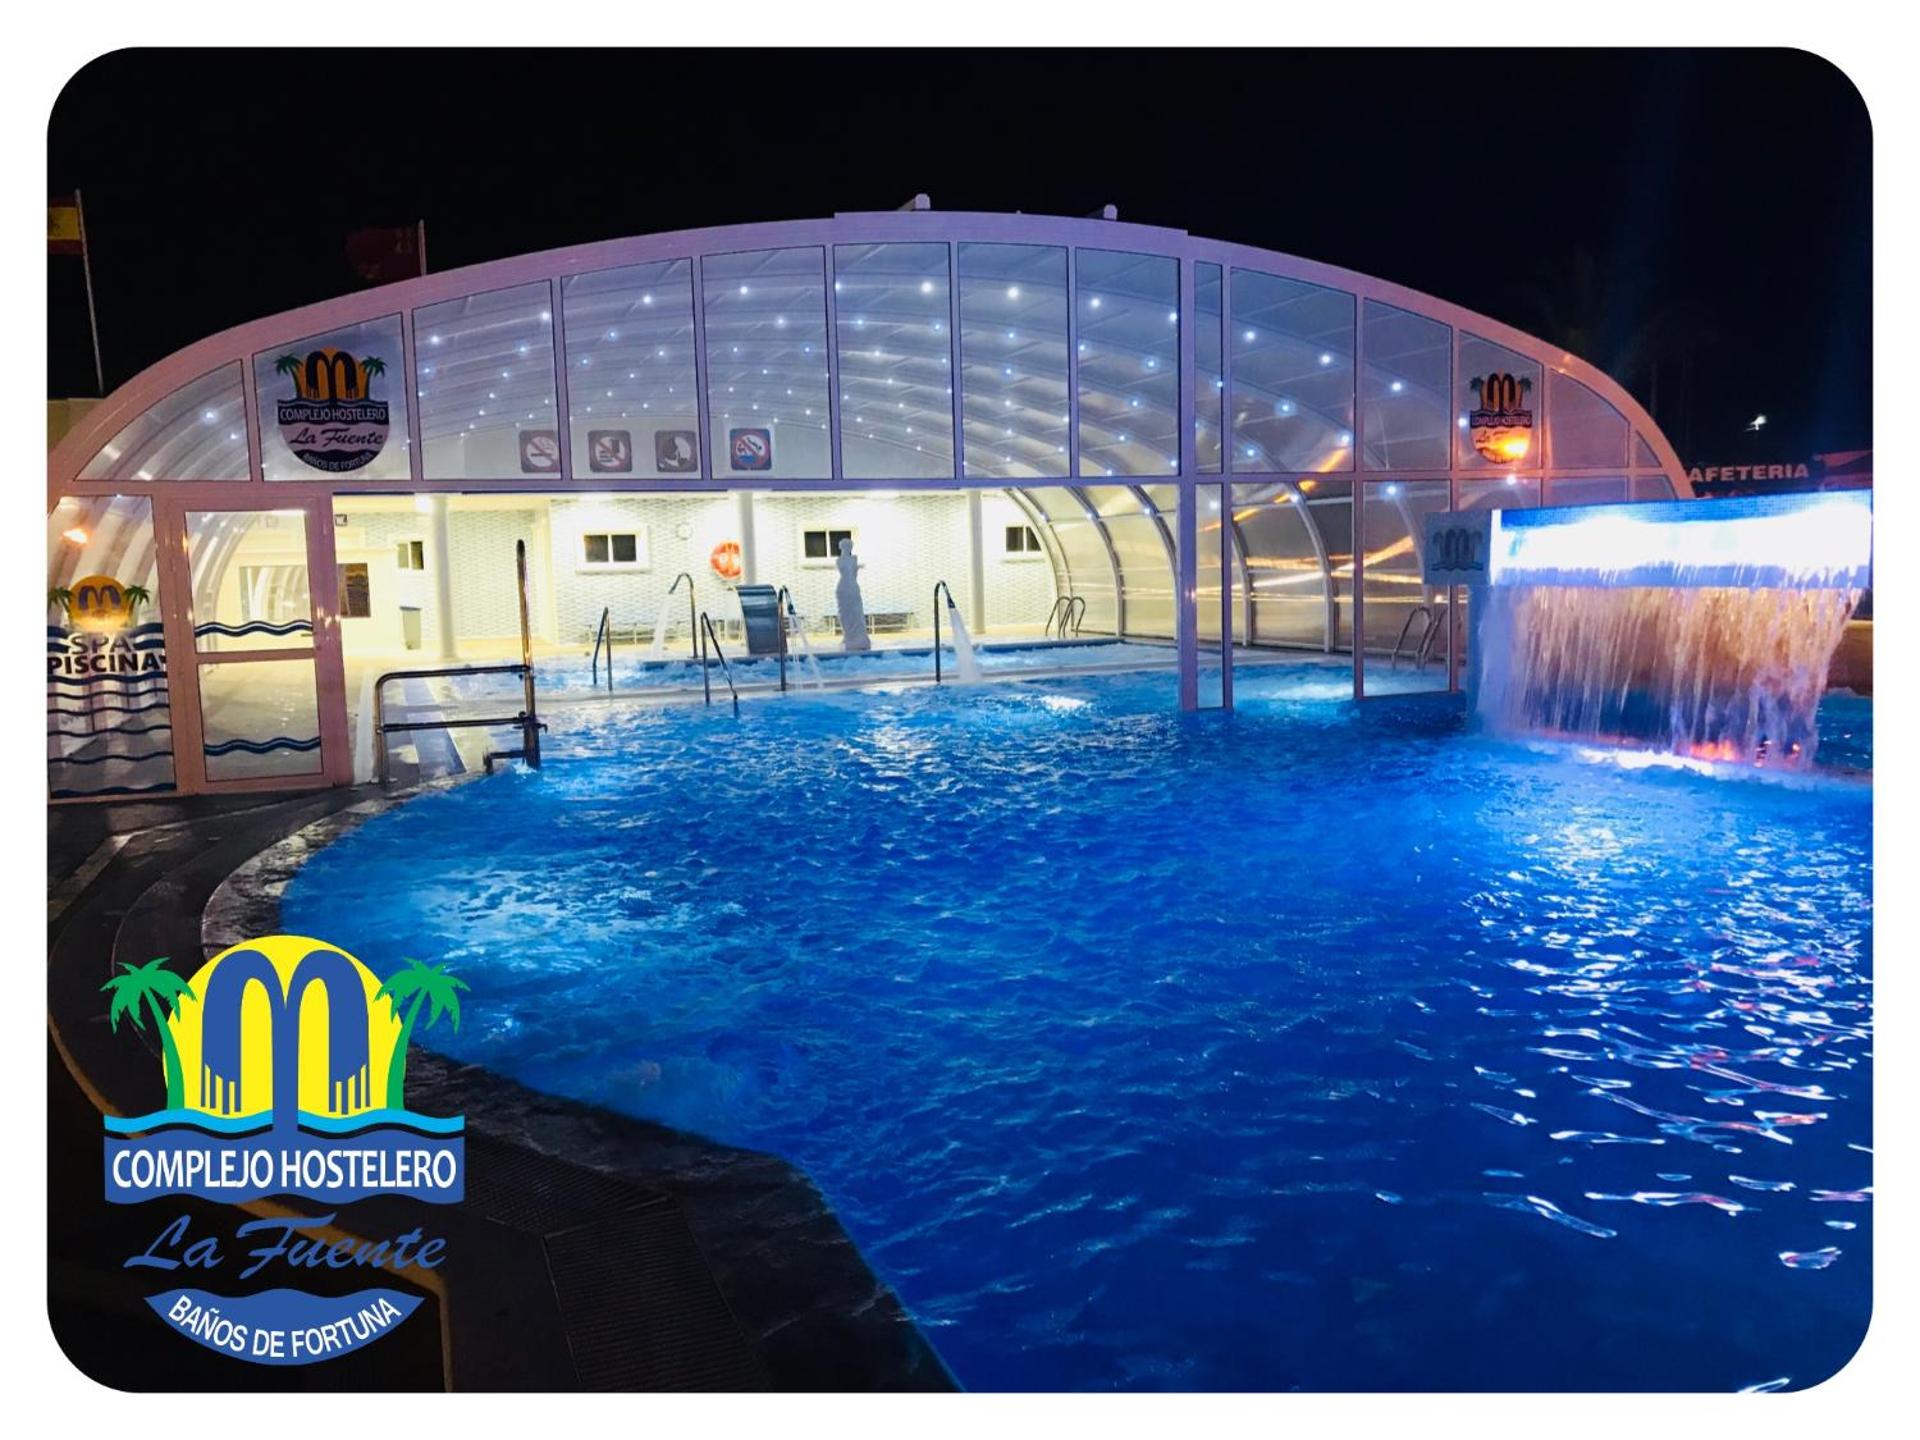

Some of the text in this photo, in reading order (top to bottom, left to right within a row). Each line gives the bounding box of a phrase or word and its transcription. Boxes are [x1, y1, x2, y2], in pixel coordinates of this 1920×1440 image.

[279, 408, 386, 420] COMPLEJO HOSTELERO
[291, 427, 384, 447] La Fuente
[70, 635, 132, 655] SPA
[47, 652, 160, 674] PISCINA
